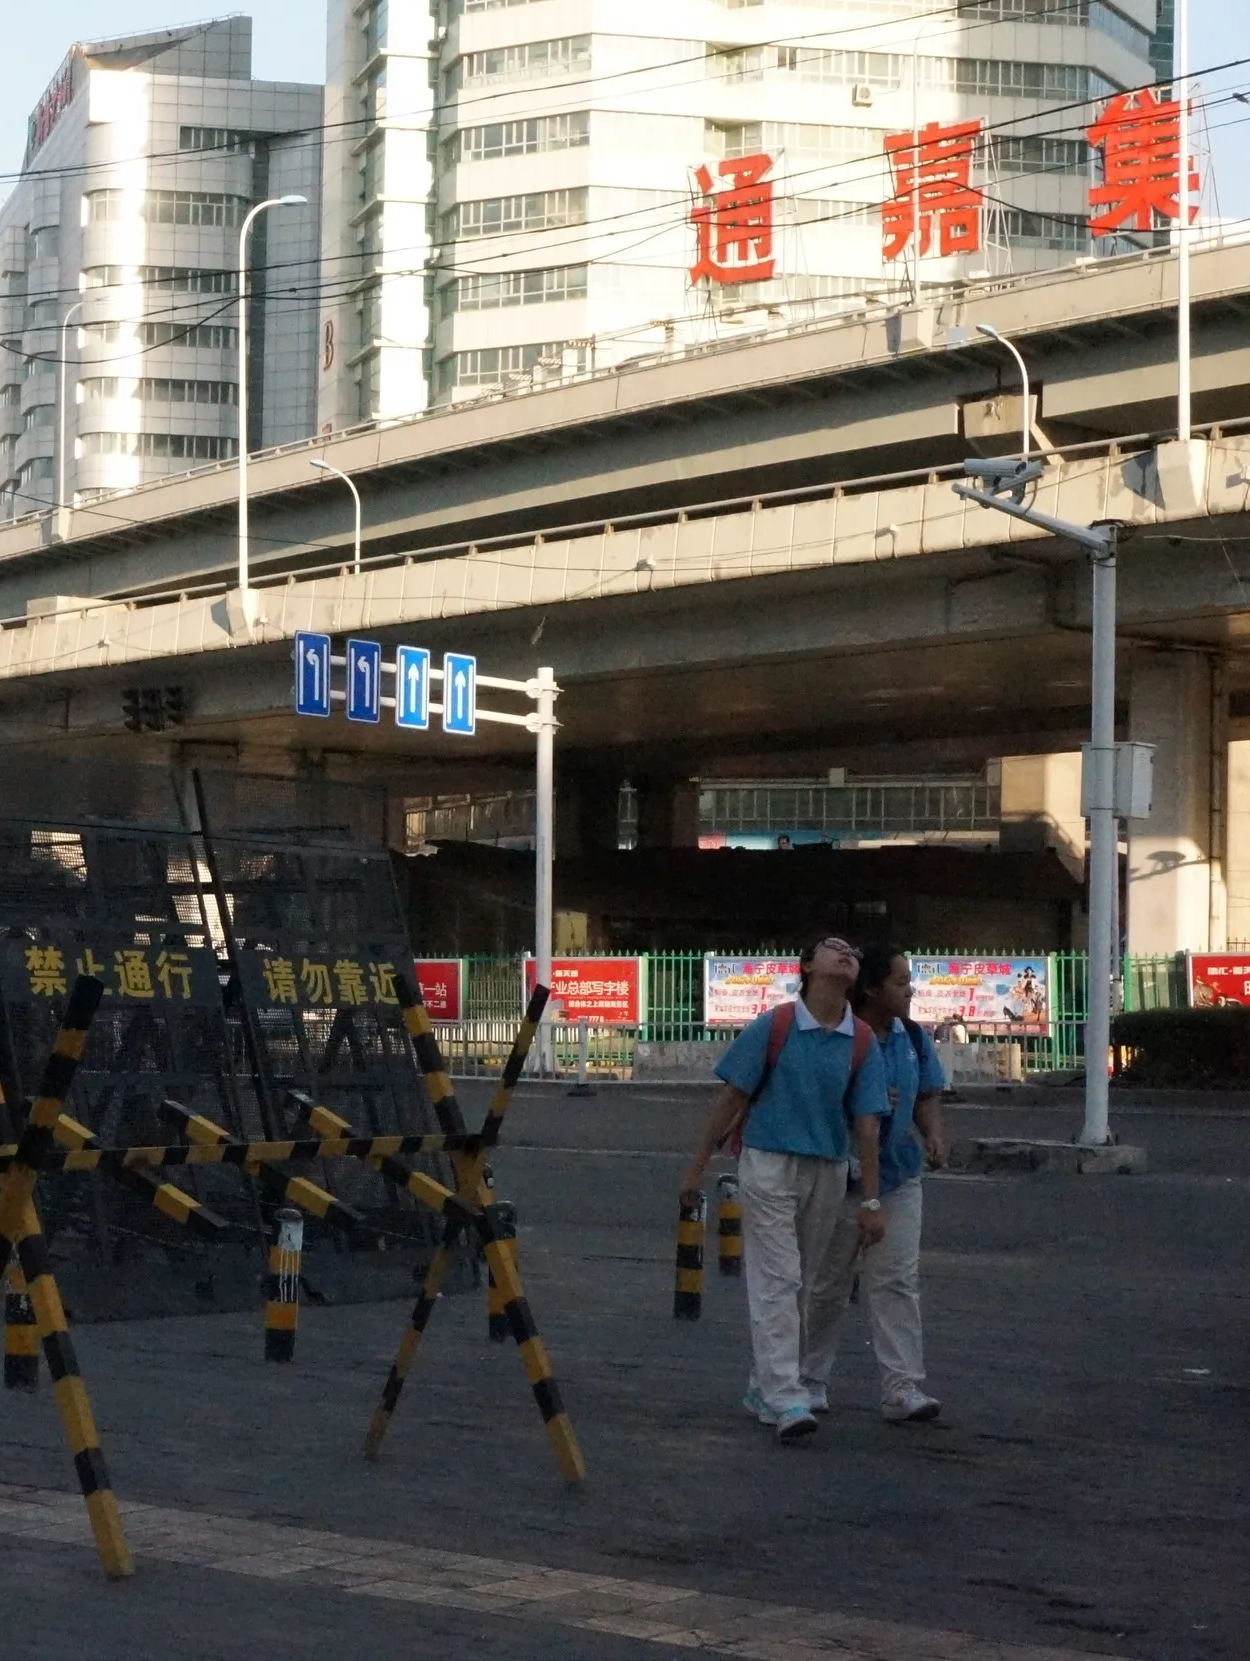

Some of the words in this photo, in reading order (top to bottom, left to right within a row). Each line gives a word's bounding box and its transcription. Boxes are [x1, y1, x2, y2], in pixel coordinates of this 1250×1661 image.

[25, 946, 192, 999] 禁止通行
[262, 957, 400, 1005] 请勿靠近
